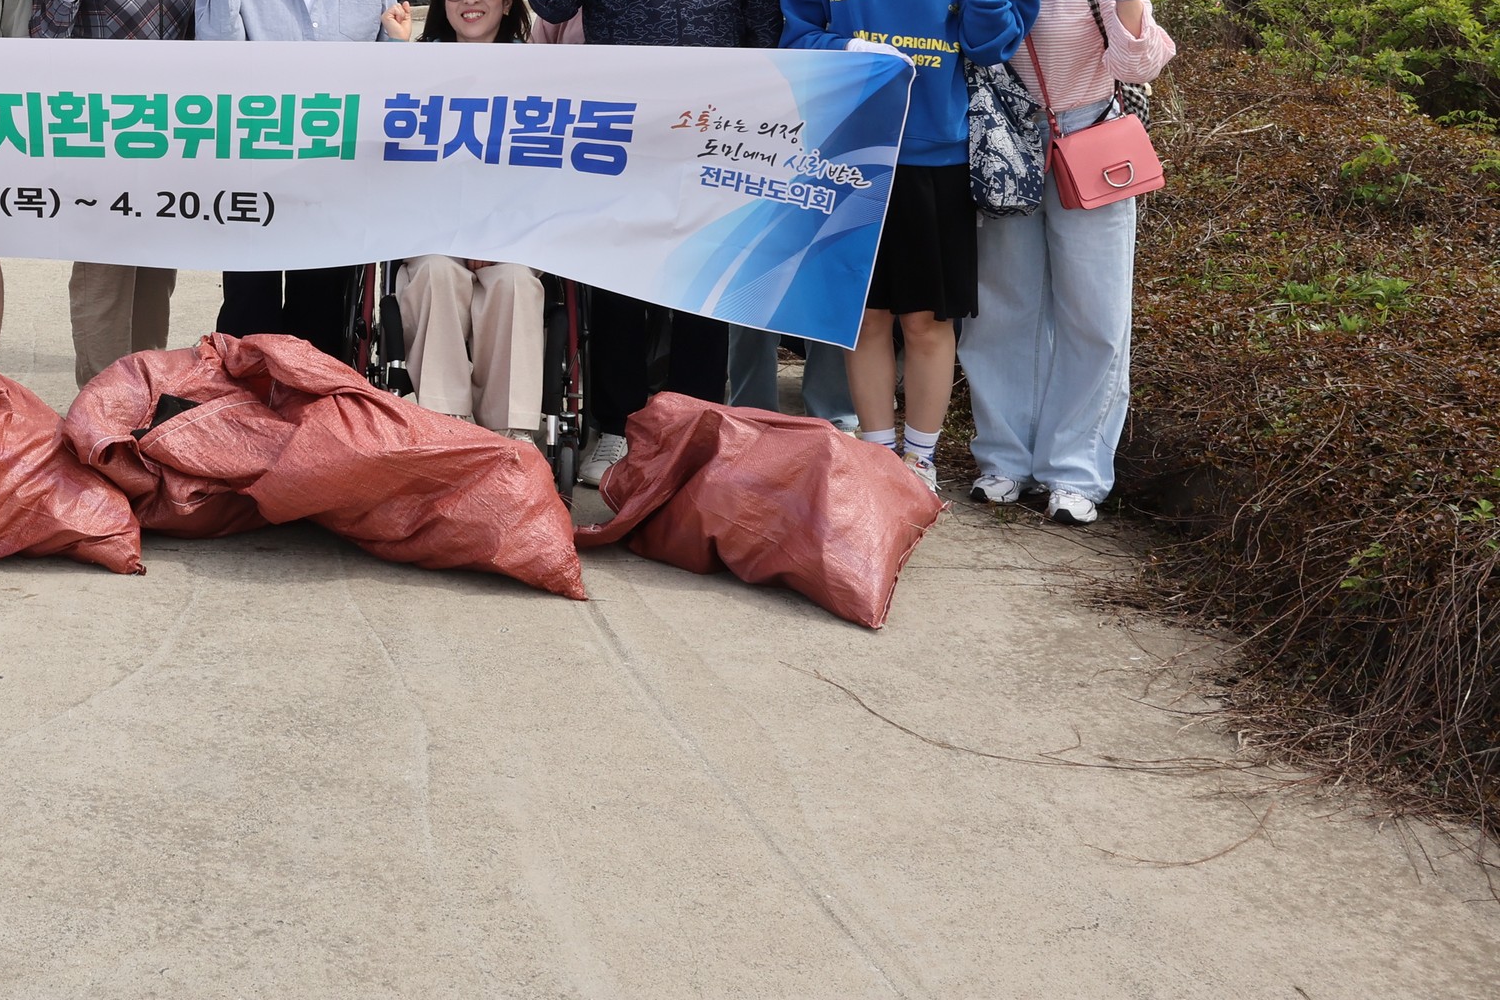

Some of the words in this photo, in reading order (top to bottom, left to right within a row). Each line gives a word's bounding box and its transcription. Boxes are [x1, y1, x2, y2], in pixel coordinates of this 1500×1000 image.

[892, 35, 960, 53] ORIGINALS
[911, 54, 941, 68] 1972
[383, 93, 637, 176] 현지활동
[670, 105, 749, 132] 소통하는
[757, 122, 804, 144] 의정
[697, 139, 777, 167] 도민에게
[783, 148, 872, 187] 신뢰받는
[110, 191, 142, 218] 4.
[156, 190, 276, 227] 20.(토)
[700, 165, 836, 213] 전라남도의회
